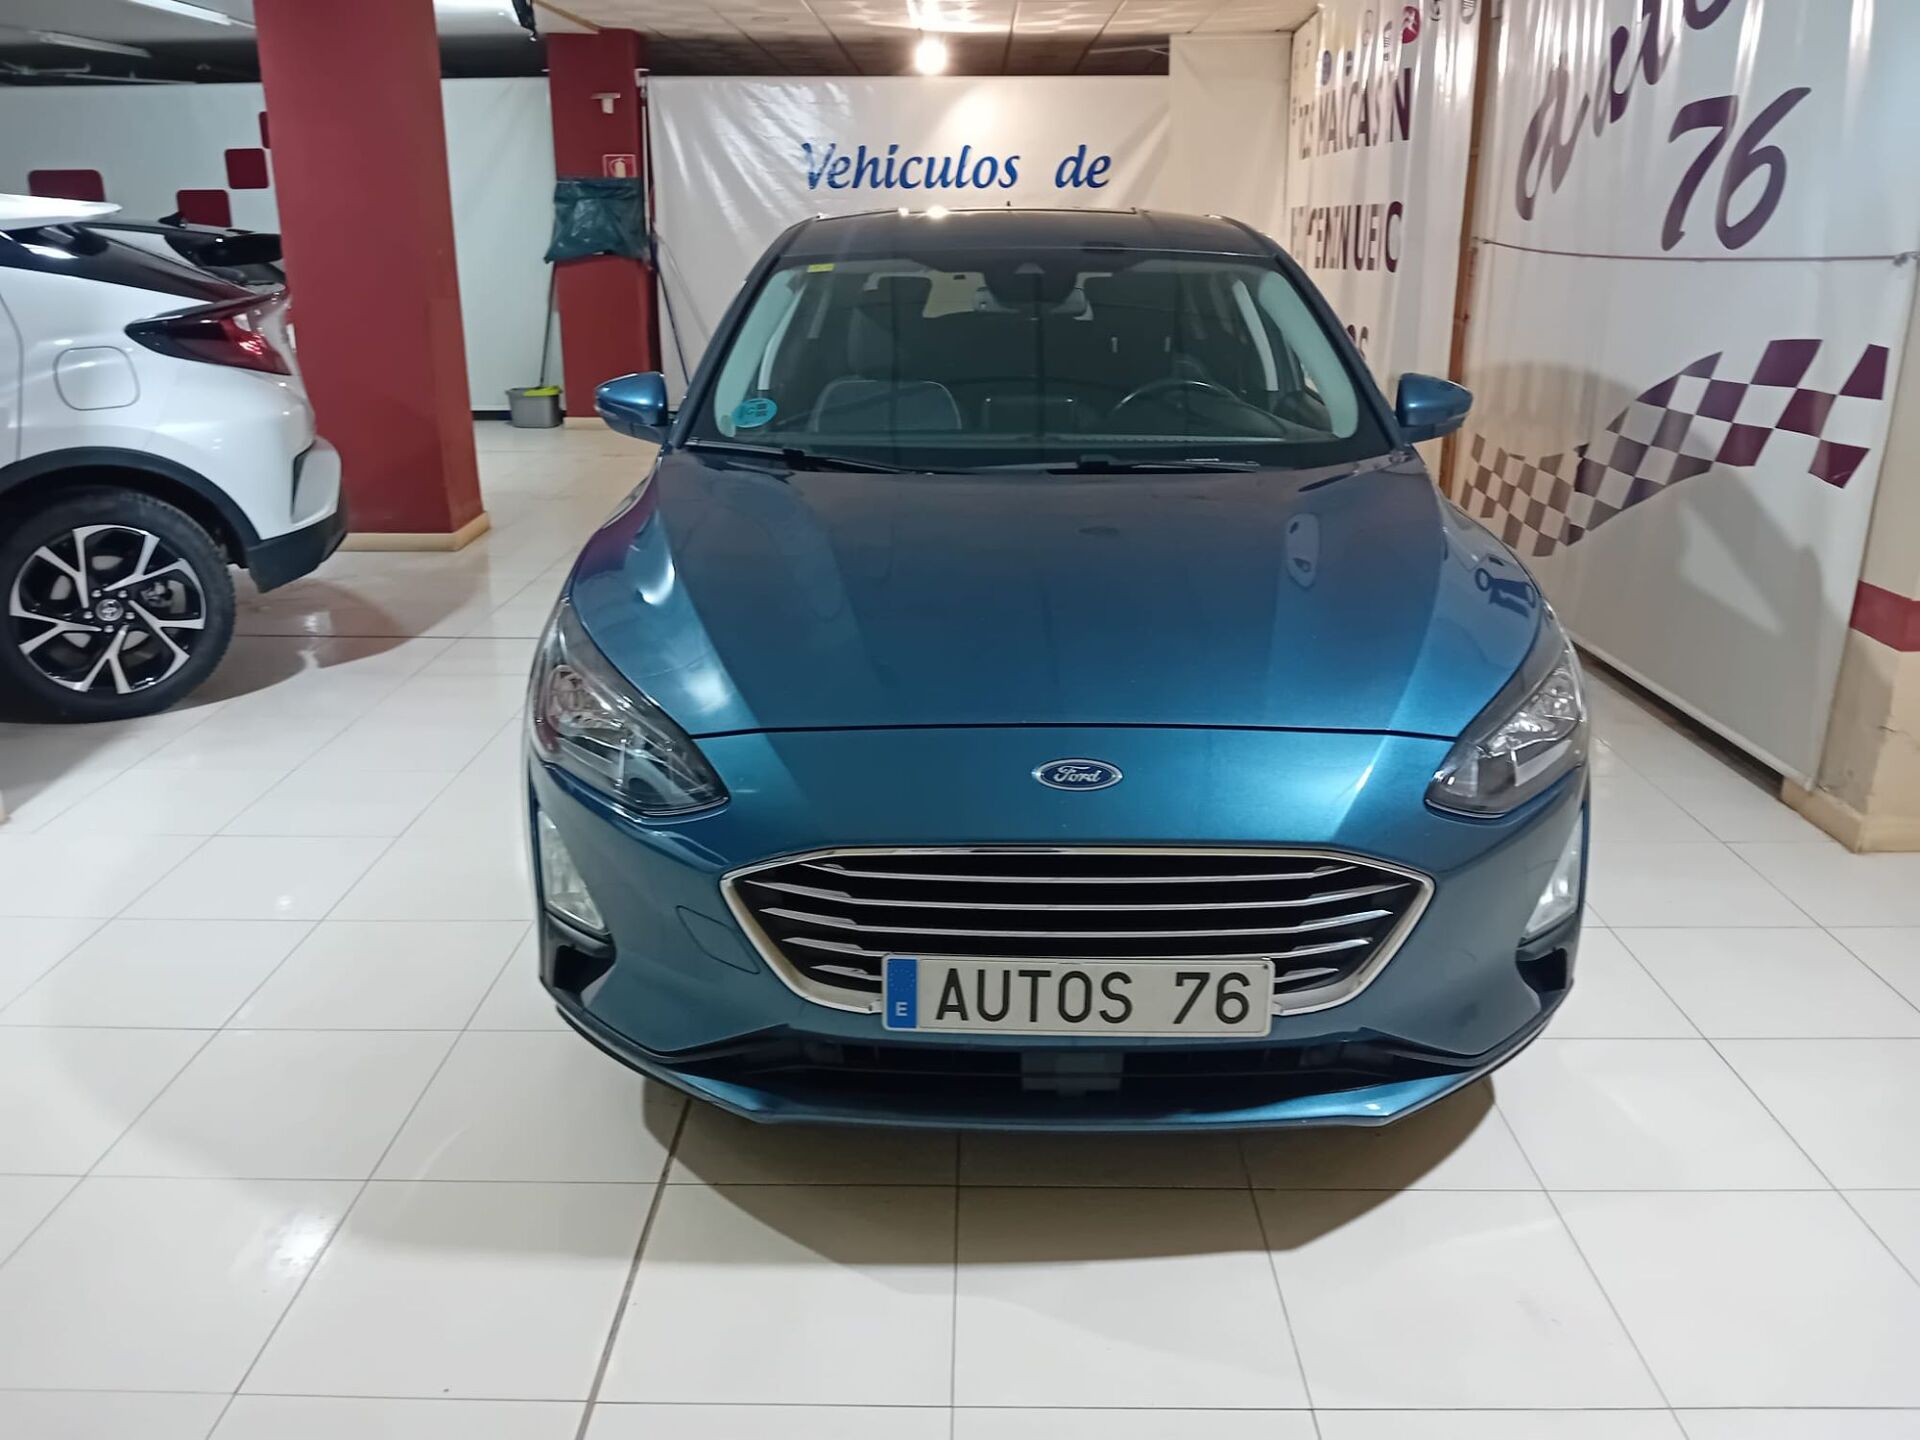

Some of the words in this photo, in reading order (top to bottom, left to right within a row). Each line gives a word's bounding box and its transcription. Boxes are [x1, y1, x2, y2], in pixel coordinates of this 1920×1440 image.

[1055, 144, 1111, 188] de
[1661, 87, 1811, 251] 76
[1053, 765, 1102, 782] Ford
[895, 1002, 907, 1016] E
[935, 968, 1133, 1024] AUTOS
[1173, 971, 1251, 1024] 76
